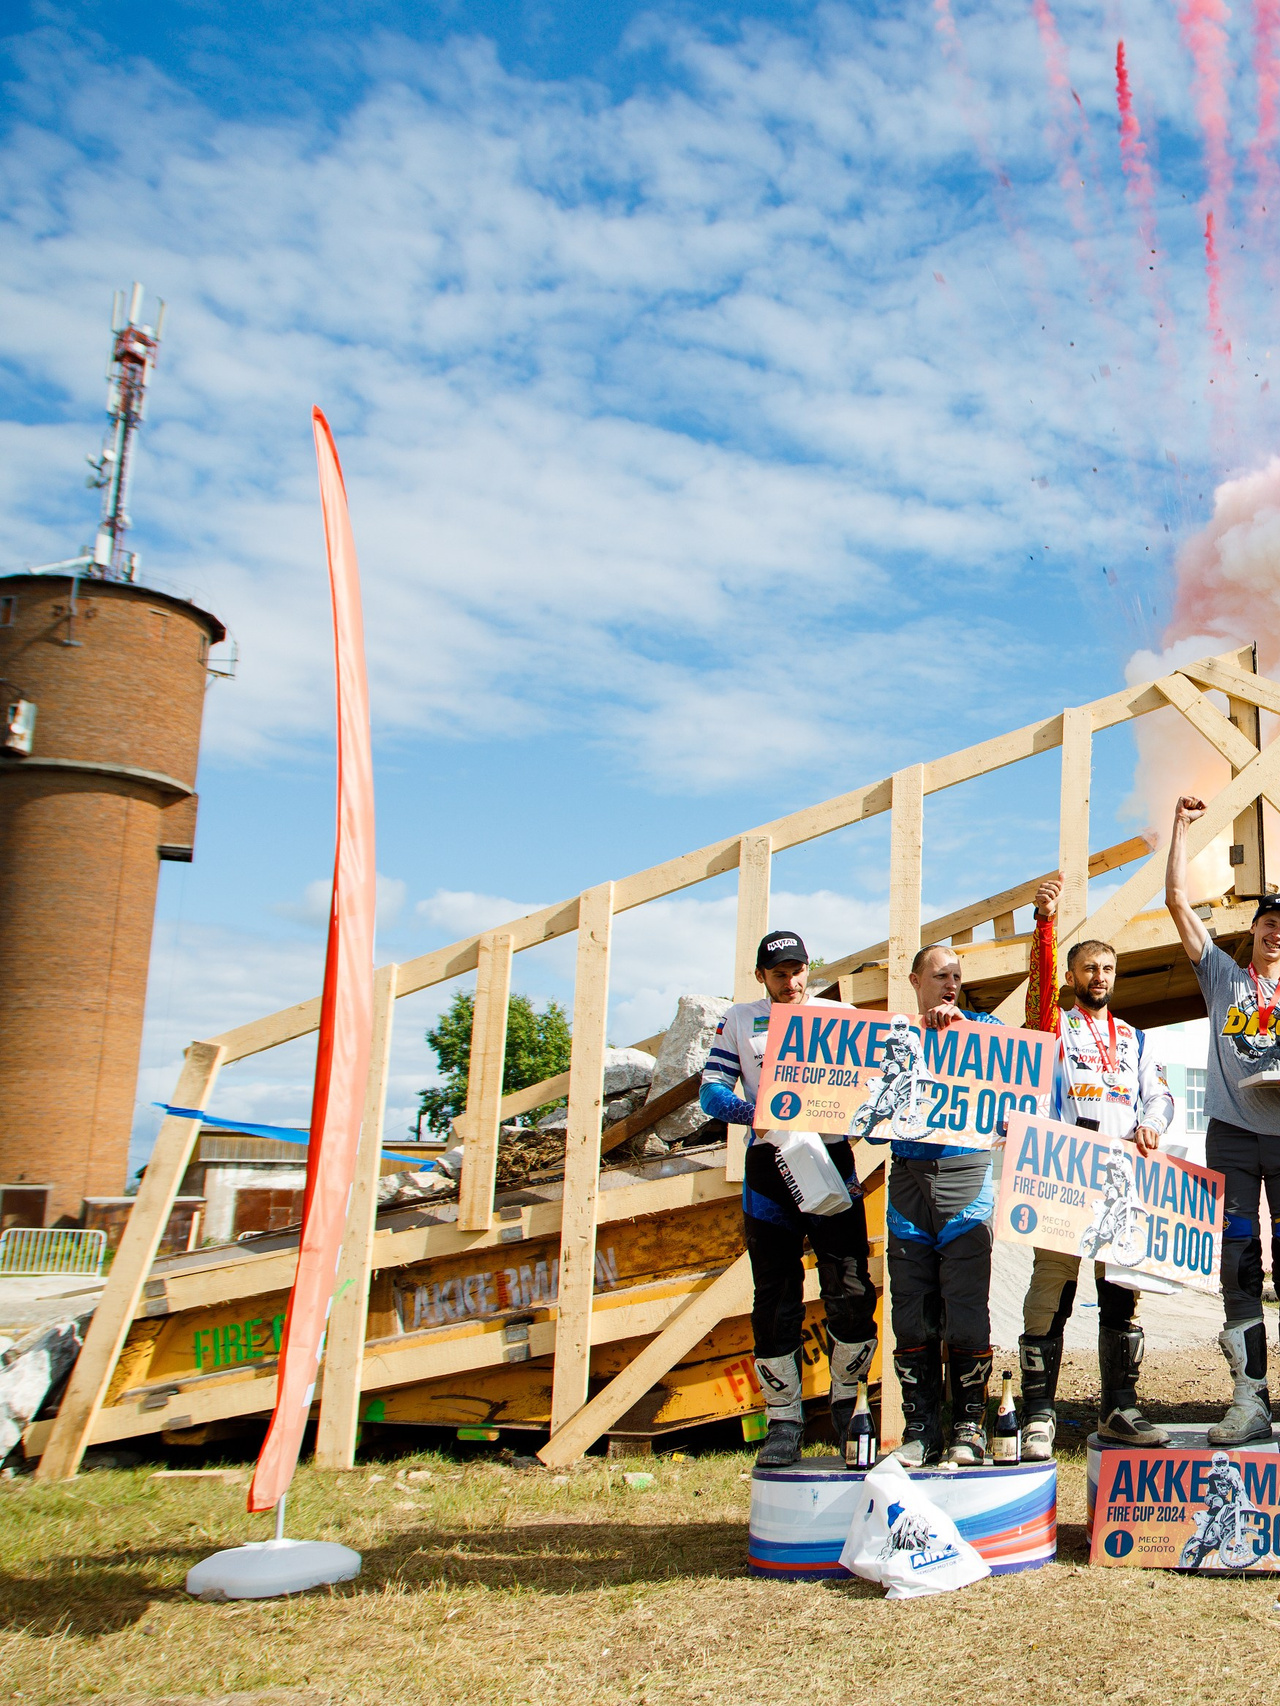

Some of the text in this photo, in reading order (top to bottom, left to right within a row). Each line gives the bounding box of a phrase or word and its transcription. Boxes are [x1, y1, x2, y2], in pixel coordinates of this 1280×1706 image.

[777, 1015, 1042, 1087] AKKEMANN
[774, 1065, 859, 1088] FIRE CUP 2024
[1068, 1083, 1104, 1098] KTM
[780, 1093, 791, 1117] 2
[805, 1109, 846, 1119] ЗОЛОТО
[807, 1099, 840, 1109] МЕСТО
[926, 1083, 969, 1131] 25
[1016, 1126, 1217, 1226] AKKEMANN
[1013, 1175, 1086, 1208] FIRE CUP 2024
[1018, 1207, 1031, 1231] 3
[1042, 1215, 1071, 1228] МЕСТО
[1041, 1225, 1075, 1239] ЗОЛОТО
[1146, 1213, 1213, 1276] 15 000
[193, 1318, 265, 1370] FIRE
[1107, 1506, 1186, 1523] FIRE CUP 2024
[1115, 1533, 1123, 1555] 1
[1137, 1545, 1175, 1553] ЗОЛОТО
[1138, 1536, 1170, 1544] МЕСТО
